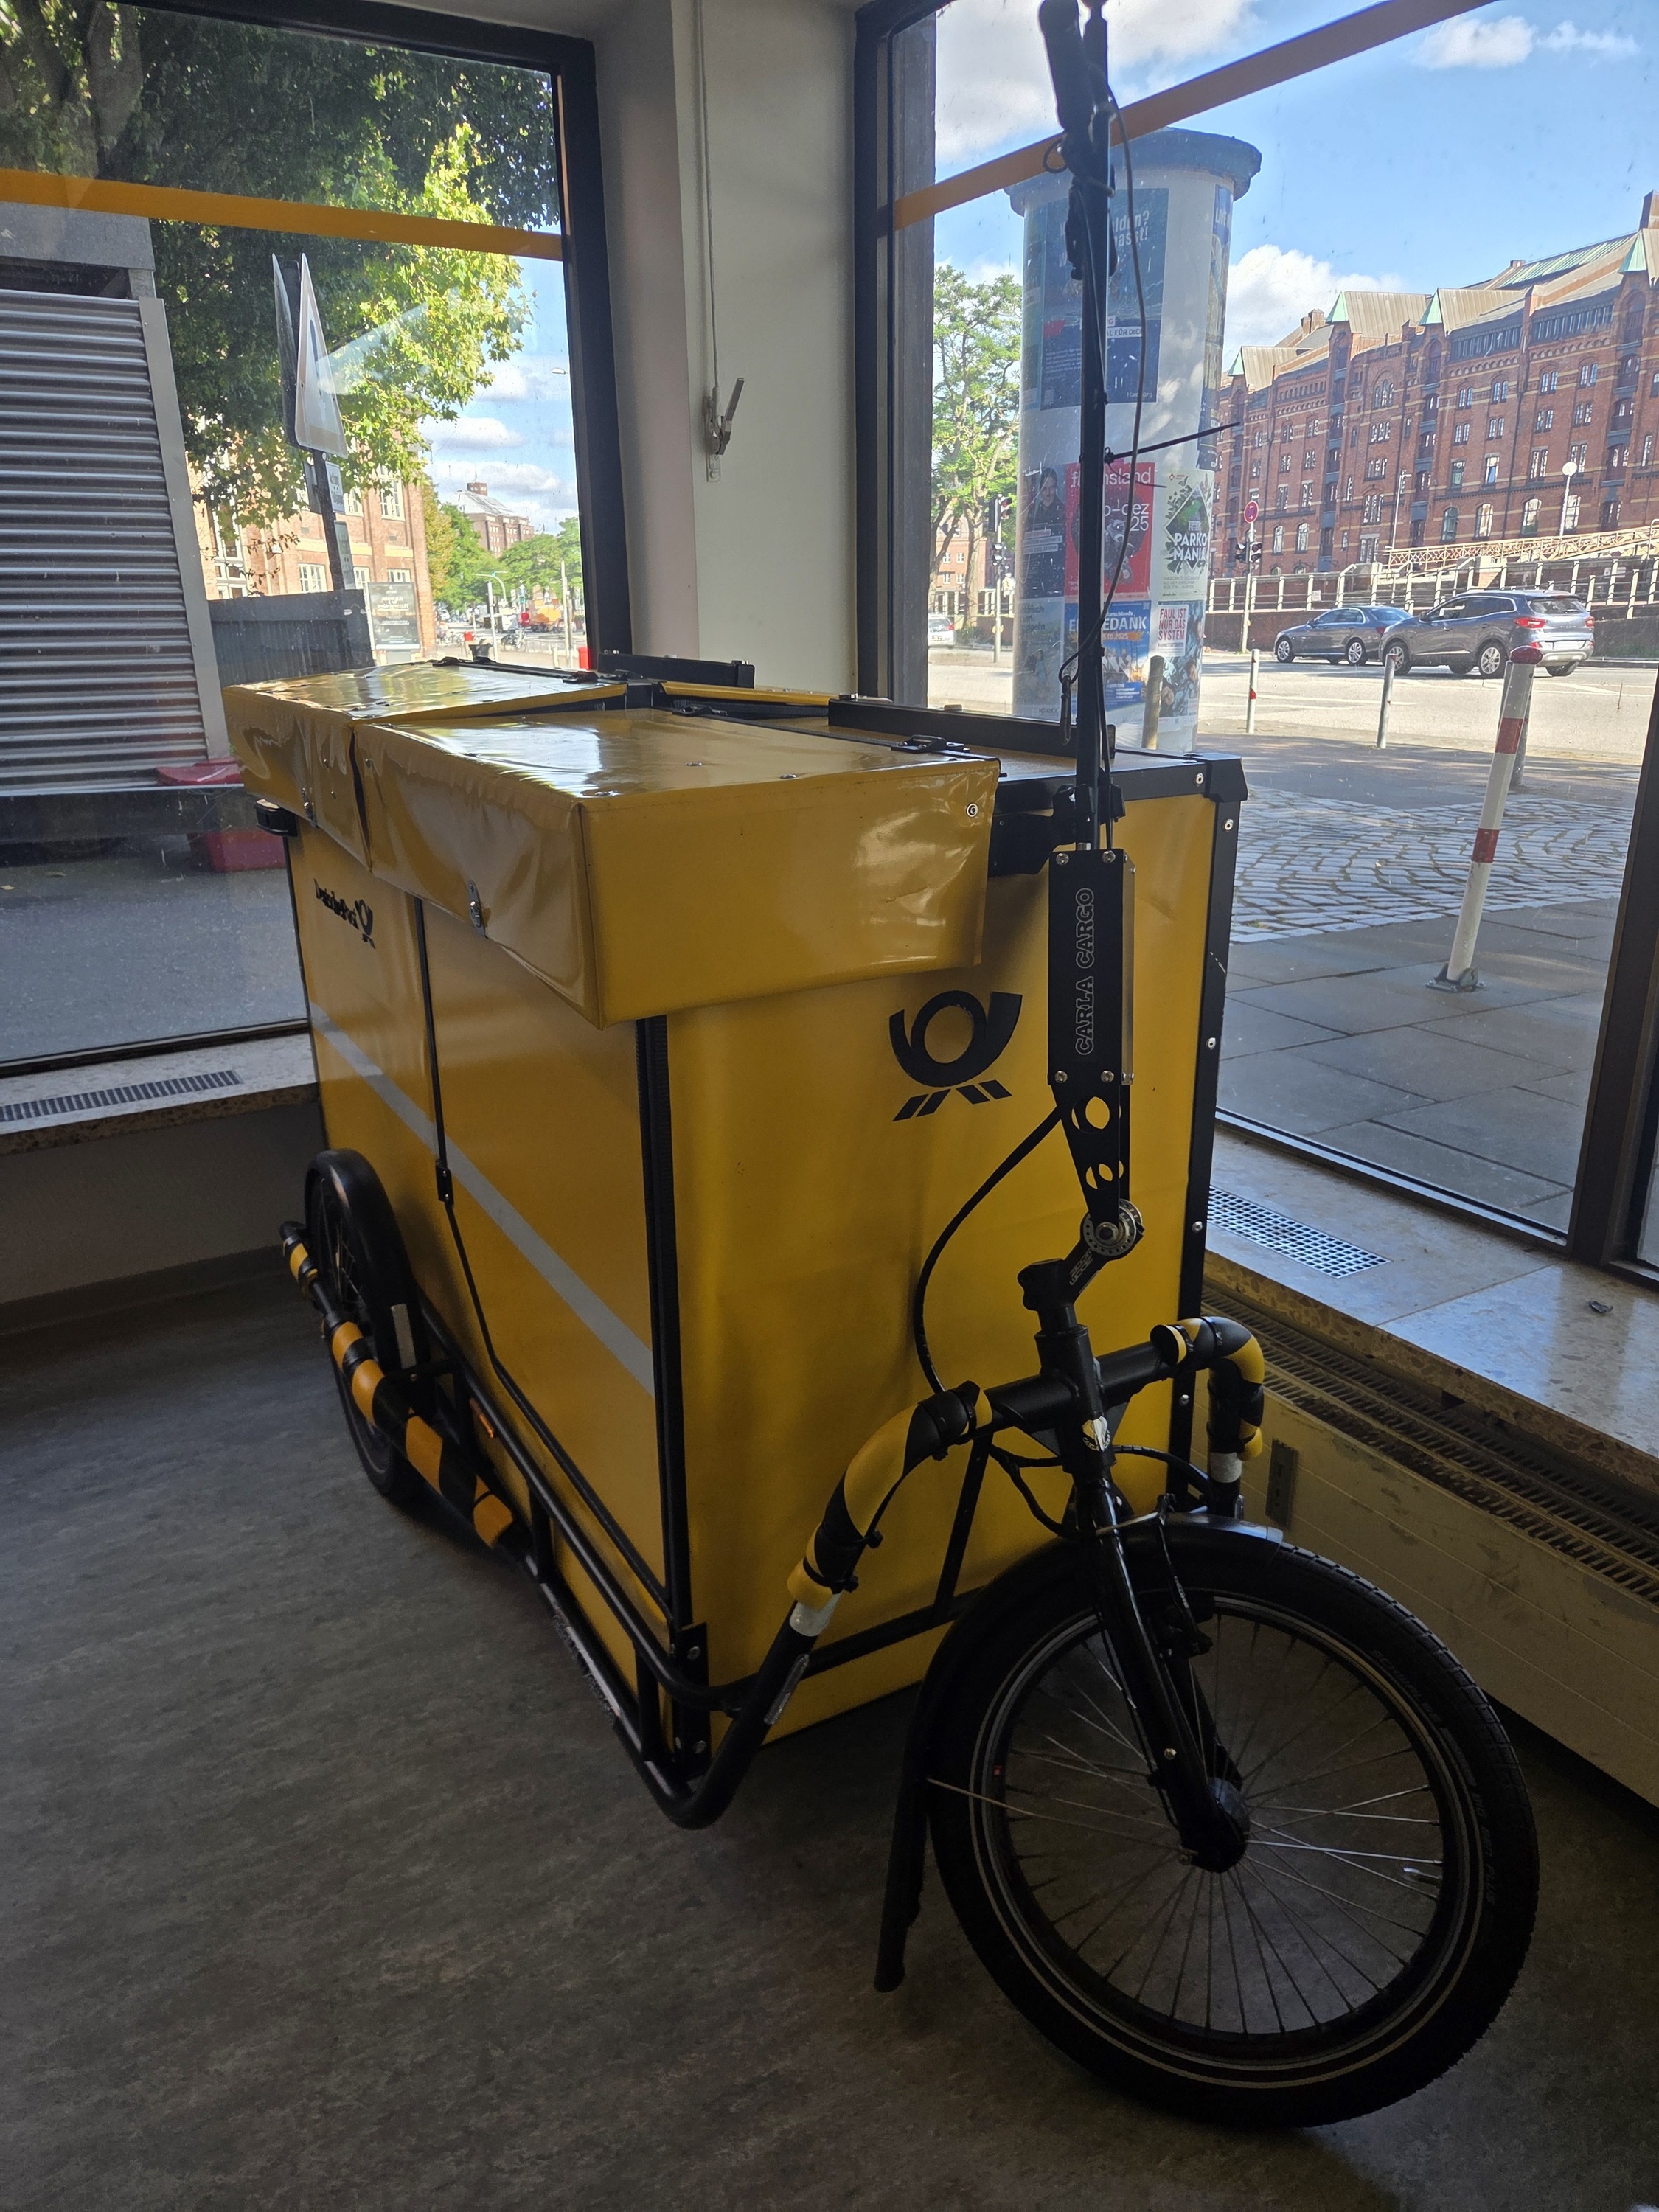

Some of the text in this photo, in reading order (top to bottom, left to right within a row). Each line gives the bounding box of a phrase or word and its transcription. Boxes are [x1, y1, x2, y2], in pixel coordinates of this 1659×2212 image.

[1130, 516, 1149, 531] 25
[1174, 532, 1207, 546] PARKO
[1173, 547, 1206, 561] MANIA
[1159, 608, 1186, 619] FAUL IST
[1158, 619, 1186, 630] NUR DAS
[1158, 630, 1185, 640] SYSTEM
[1075, 887, 1094, 1055] CARLA CARGO
